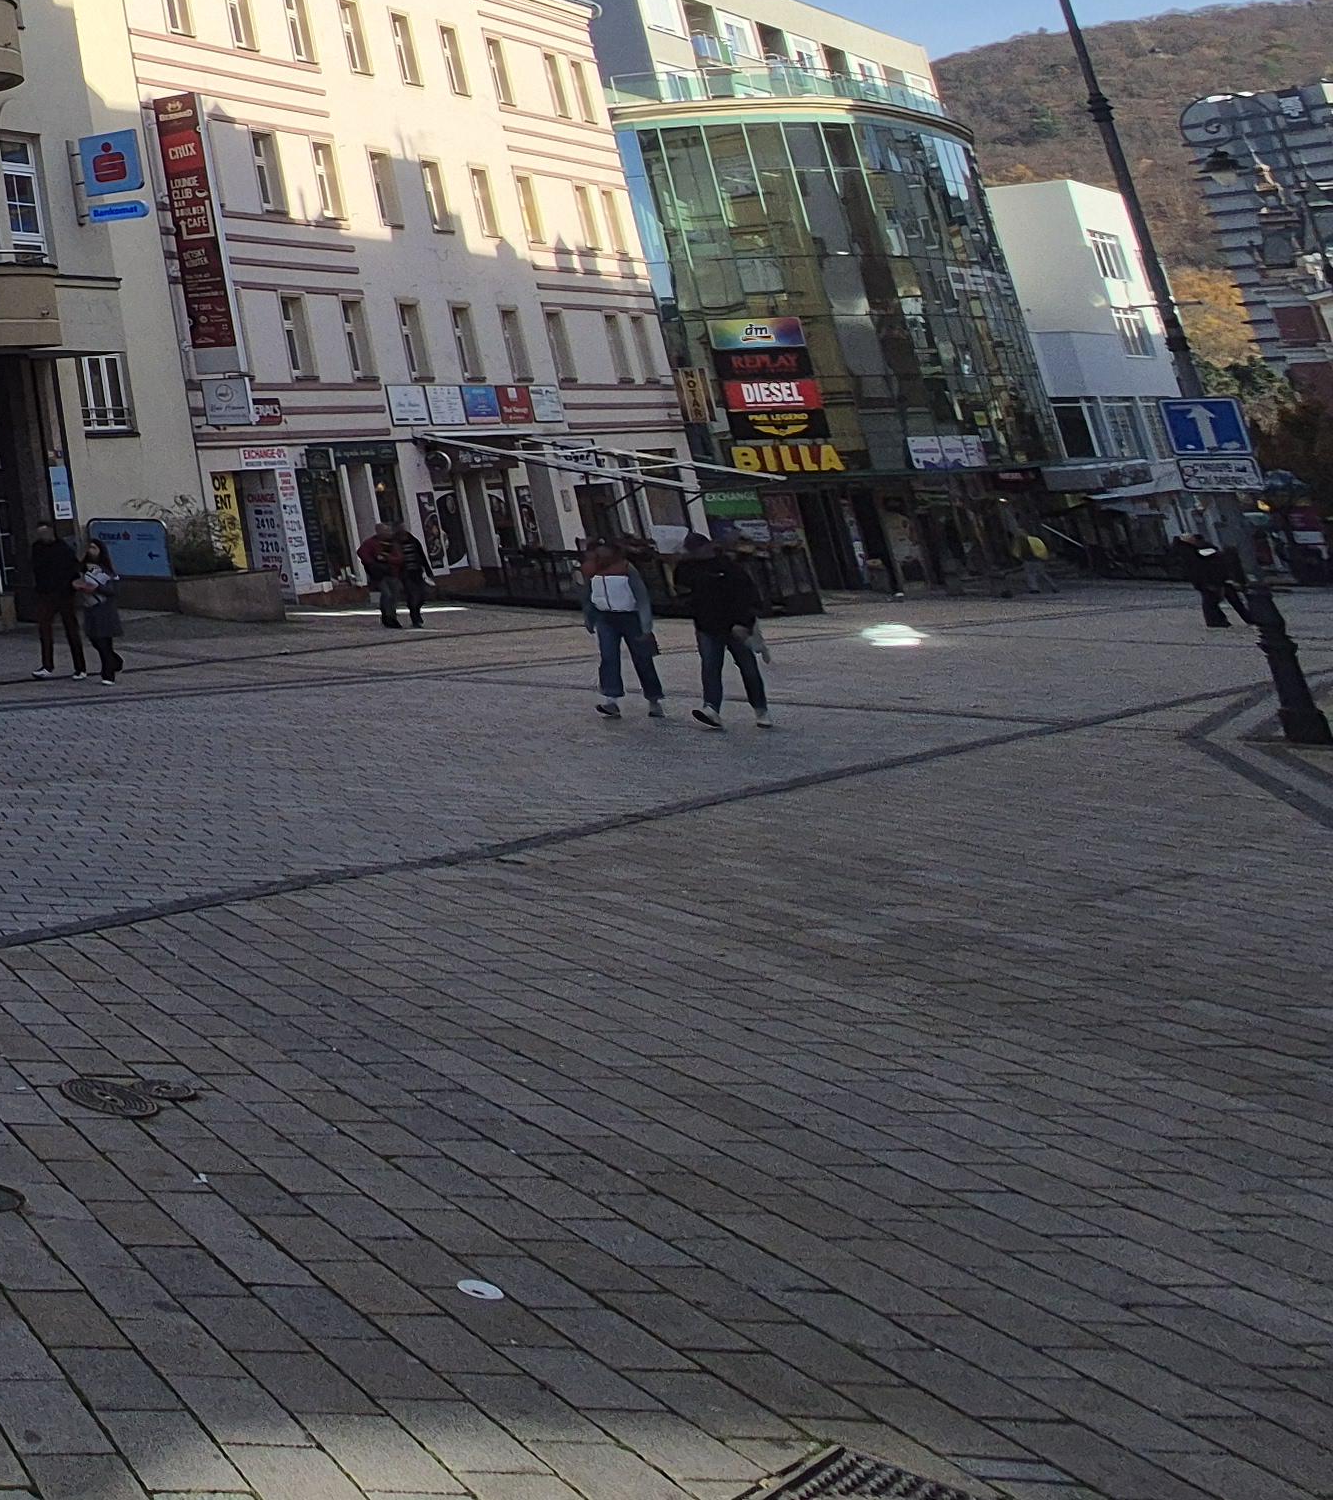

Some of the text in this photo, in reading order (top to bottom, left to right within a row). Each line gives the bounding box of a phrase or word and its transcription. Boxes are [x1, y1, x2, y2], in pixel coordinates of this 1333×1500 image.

[168, 142, 197, 160] CRUX
[170, 175, 200, 190] LOUNGE
[171, 188, 193, 200] CLUB
[731, 353, 799, 369] REPLAY
[741, 381, 805, 404] DIESEL
[731, 444, 846, 472] BILLA
[247, 493, 277, 504] CHANGE
[704, 491, 758, 502] EXCHANGE
